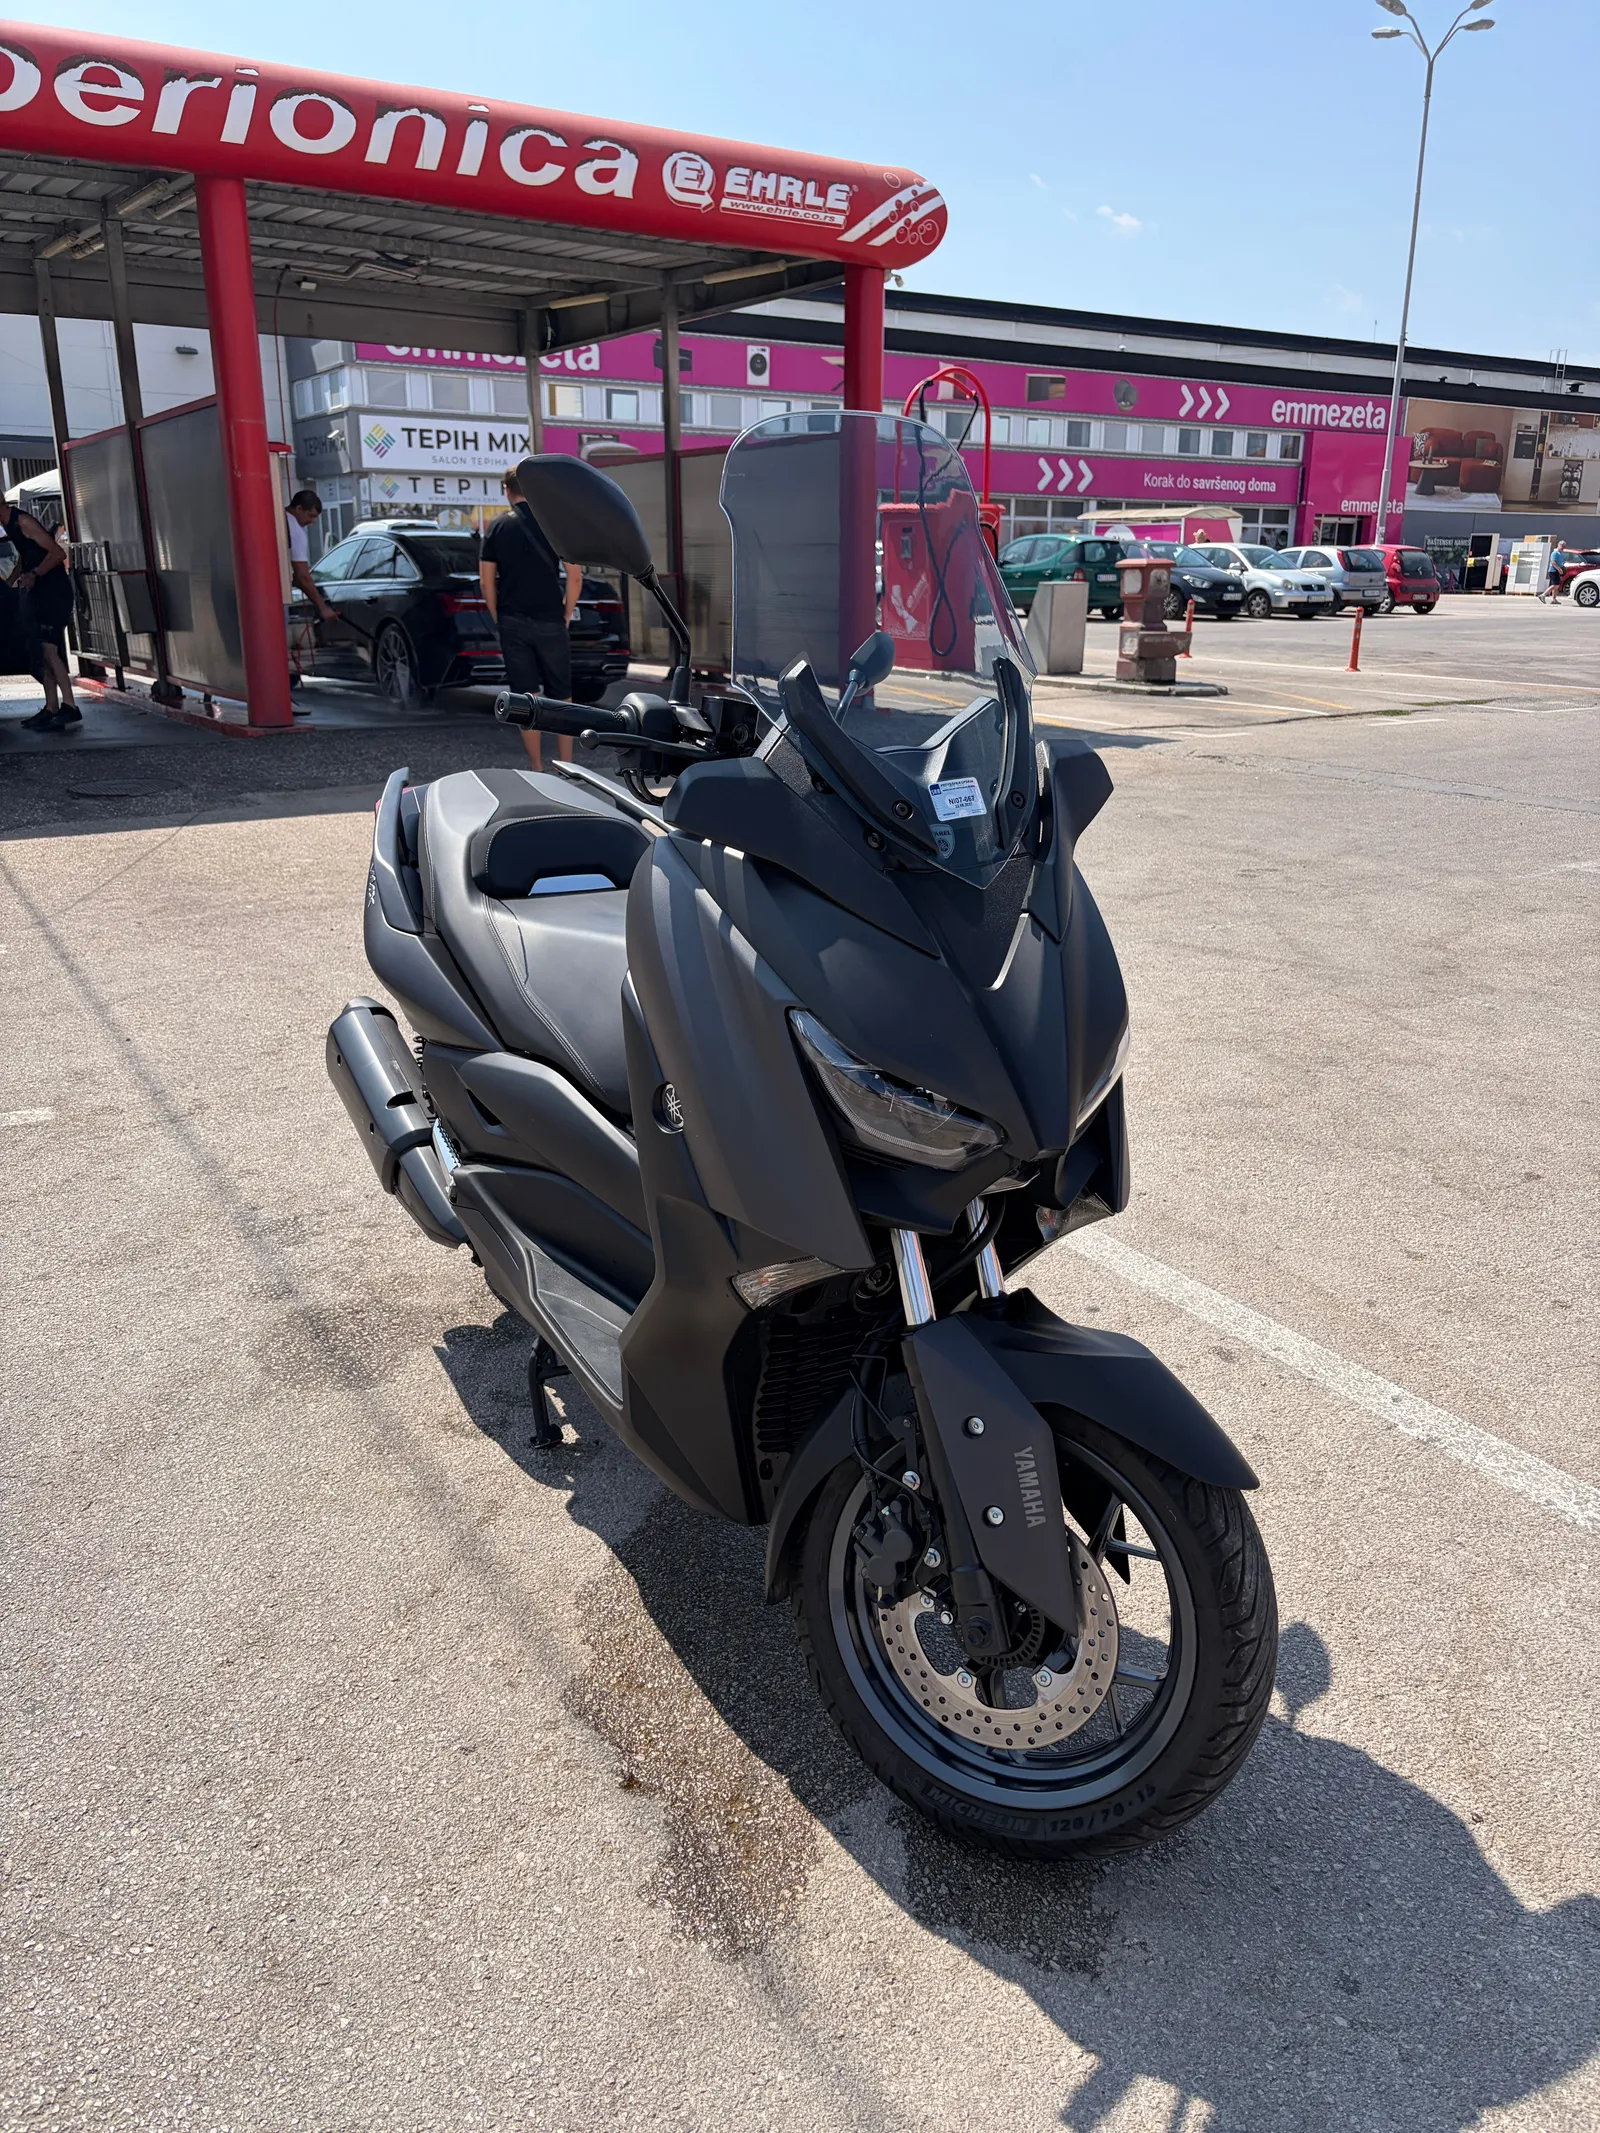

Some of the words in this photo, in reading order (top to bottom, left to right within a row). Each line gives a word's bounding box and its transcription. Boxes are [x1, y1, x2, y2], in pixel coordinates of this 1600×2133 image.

[723, 166, 851, 215] EHRLE
[729, 200, 836, 223] www.ehrle.co.rs
[1271, 399, 1387, 430] emmezeta
[401, 427, 479, 452] TEPIH
[488, 432, 532, 454] MIX
[431, 455, 467, 466] SALON
[471, 457, 509, 467] TEPIHA
[408, 476, 505, 497] TEPI
[1143, 472, 1174, 488] Korak
[1176, 474, 1191, 489] do
[1192, 476, 1245, 495] savršenog
[1247, 477, 1277, 493] doma
[1340, 499, 1405, 514] emmeeta
[1013, 1445, 1047, 1529] YAMAHA
[926, 1786, 1032, 1833] MICHELIN
